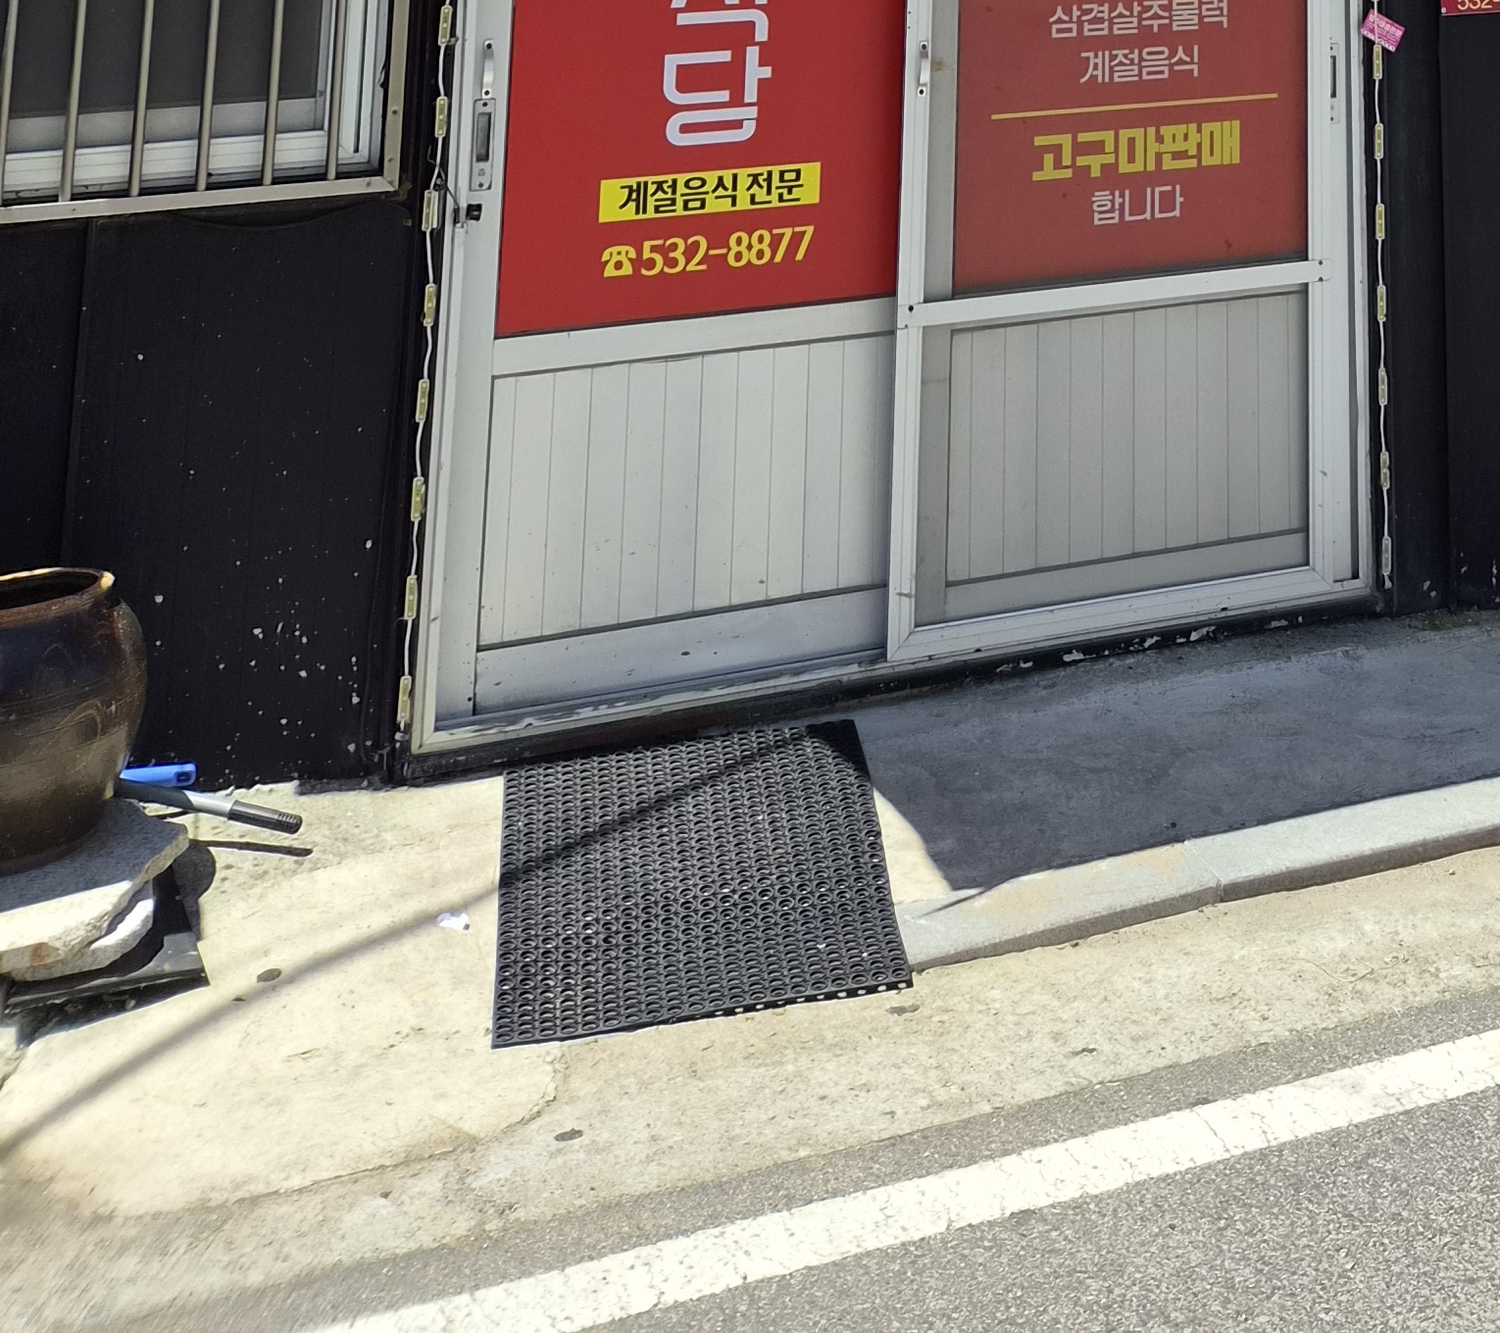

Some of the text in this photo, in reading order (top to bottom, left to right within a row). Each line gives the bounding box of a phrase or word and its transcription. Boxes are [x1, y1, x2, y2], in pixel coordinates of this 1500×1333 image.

[1079, 45, 1200, 84] 계절음식
[1031, 120, 1241, 181] 고구마판매
[618, 168, 805, 217] 계절음식 전문
[1091, 185, 1184, 226] 합니다
[640, 225, 815, 277] 532-8877
